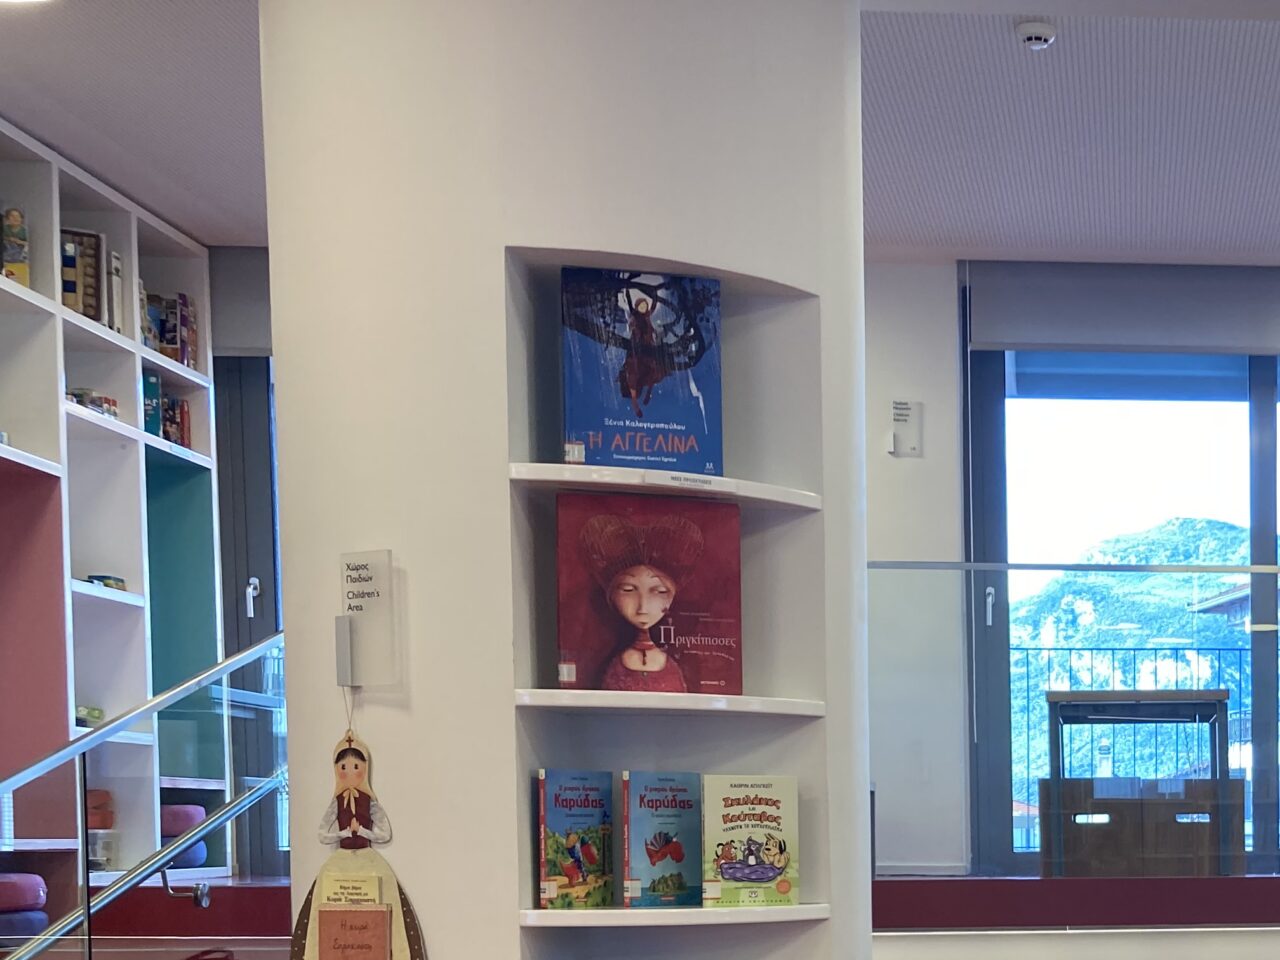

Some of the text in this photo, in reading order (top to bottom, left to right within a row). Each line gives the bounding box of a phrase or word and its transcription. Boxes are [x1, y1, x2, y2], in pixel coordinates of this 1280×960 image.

[611, 432, 699, 453] ΑΓΓΕΛΙΝΑ
[345, 563, 369, 572] Χώρος
[346, 574, 373, 584] Παιδιών
[347, 589, 380, 600] Children's
[347, 603, 363, 612] Area
[554, 793, 605, 811] Καρύδας
[639, 794, 693, 811] Καρύδας
